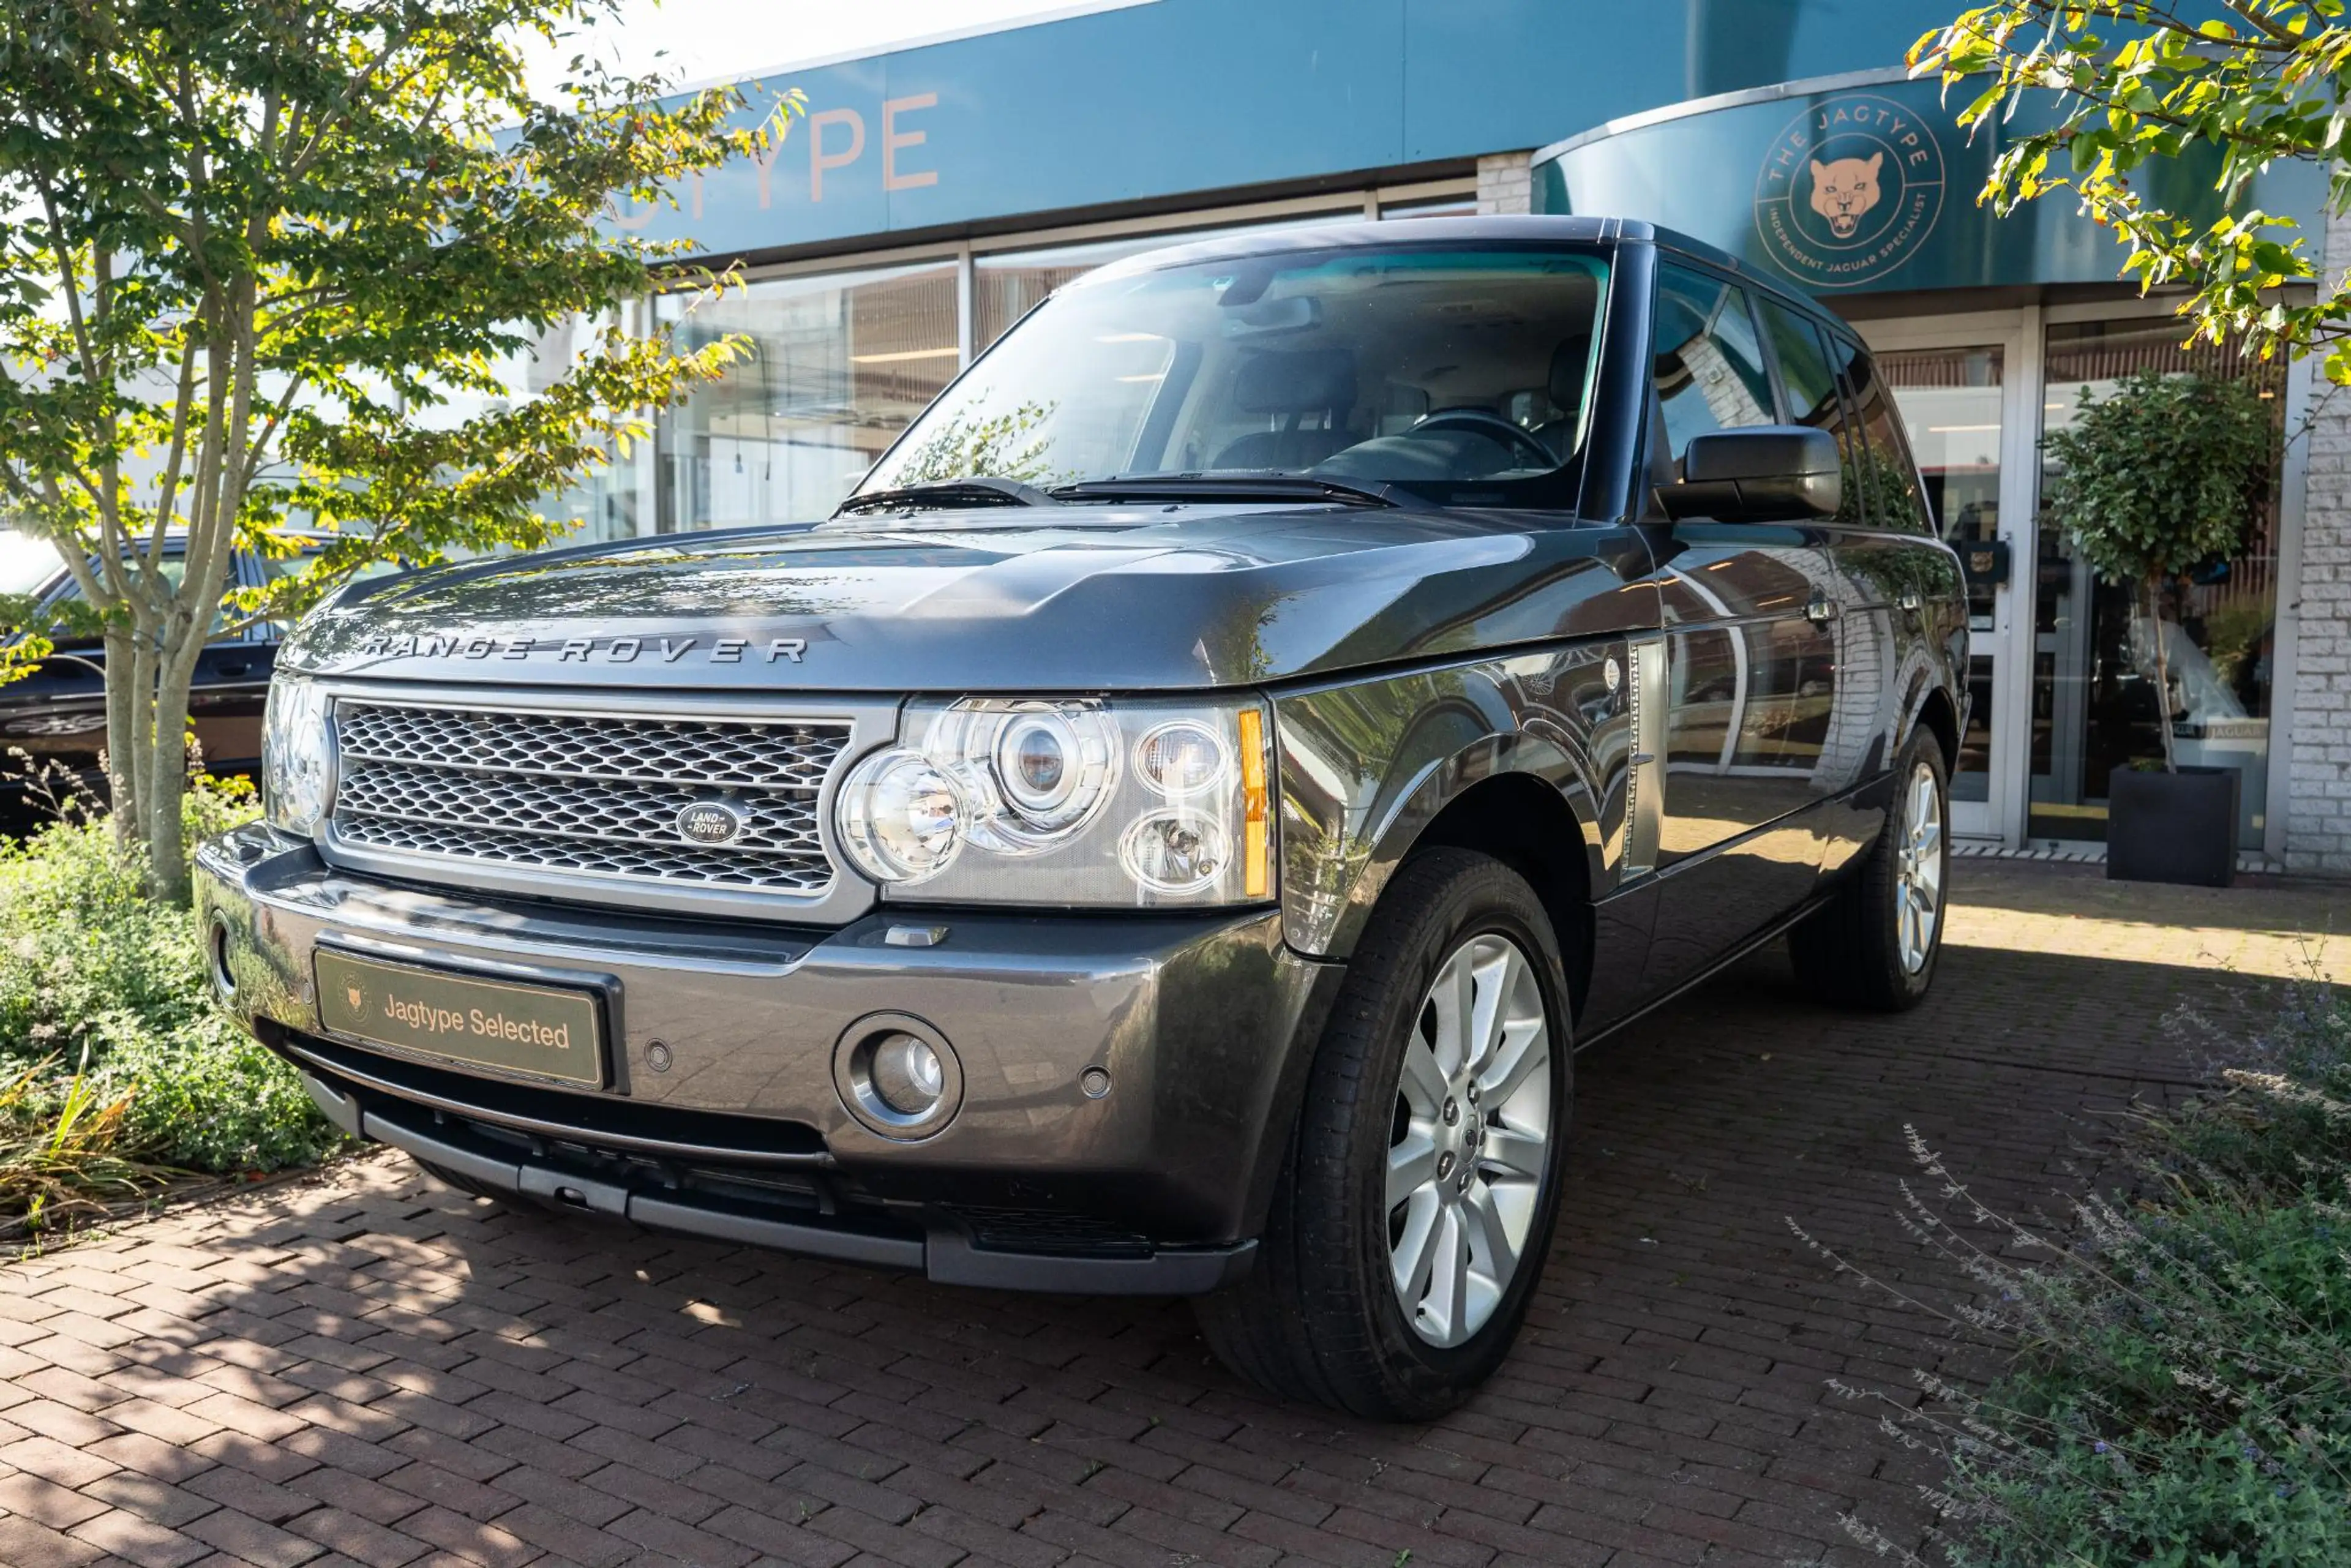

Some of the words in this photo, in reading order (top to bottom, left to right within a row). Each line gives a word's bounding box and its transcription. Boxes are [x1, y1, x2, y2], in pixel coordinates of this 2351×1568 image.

[1769, 130, 1807, 181] THE
[1818, 105, 1929, 167] JAGTYPE
[1770, 208, 1823, 270] INDEPENDENT
[1827, 255, 1877, 272] JAGUAR
[1880, 192, 1927, 257] SPECIALIST
[365, 635, 537, 659] RANGE
[558, 638, 808, 663] ROVER
[384, 994, 463, 1033] Jagtype
[470, 1008, 570, 1049] Selected
